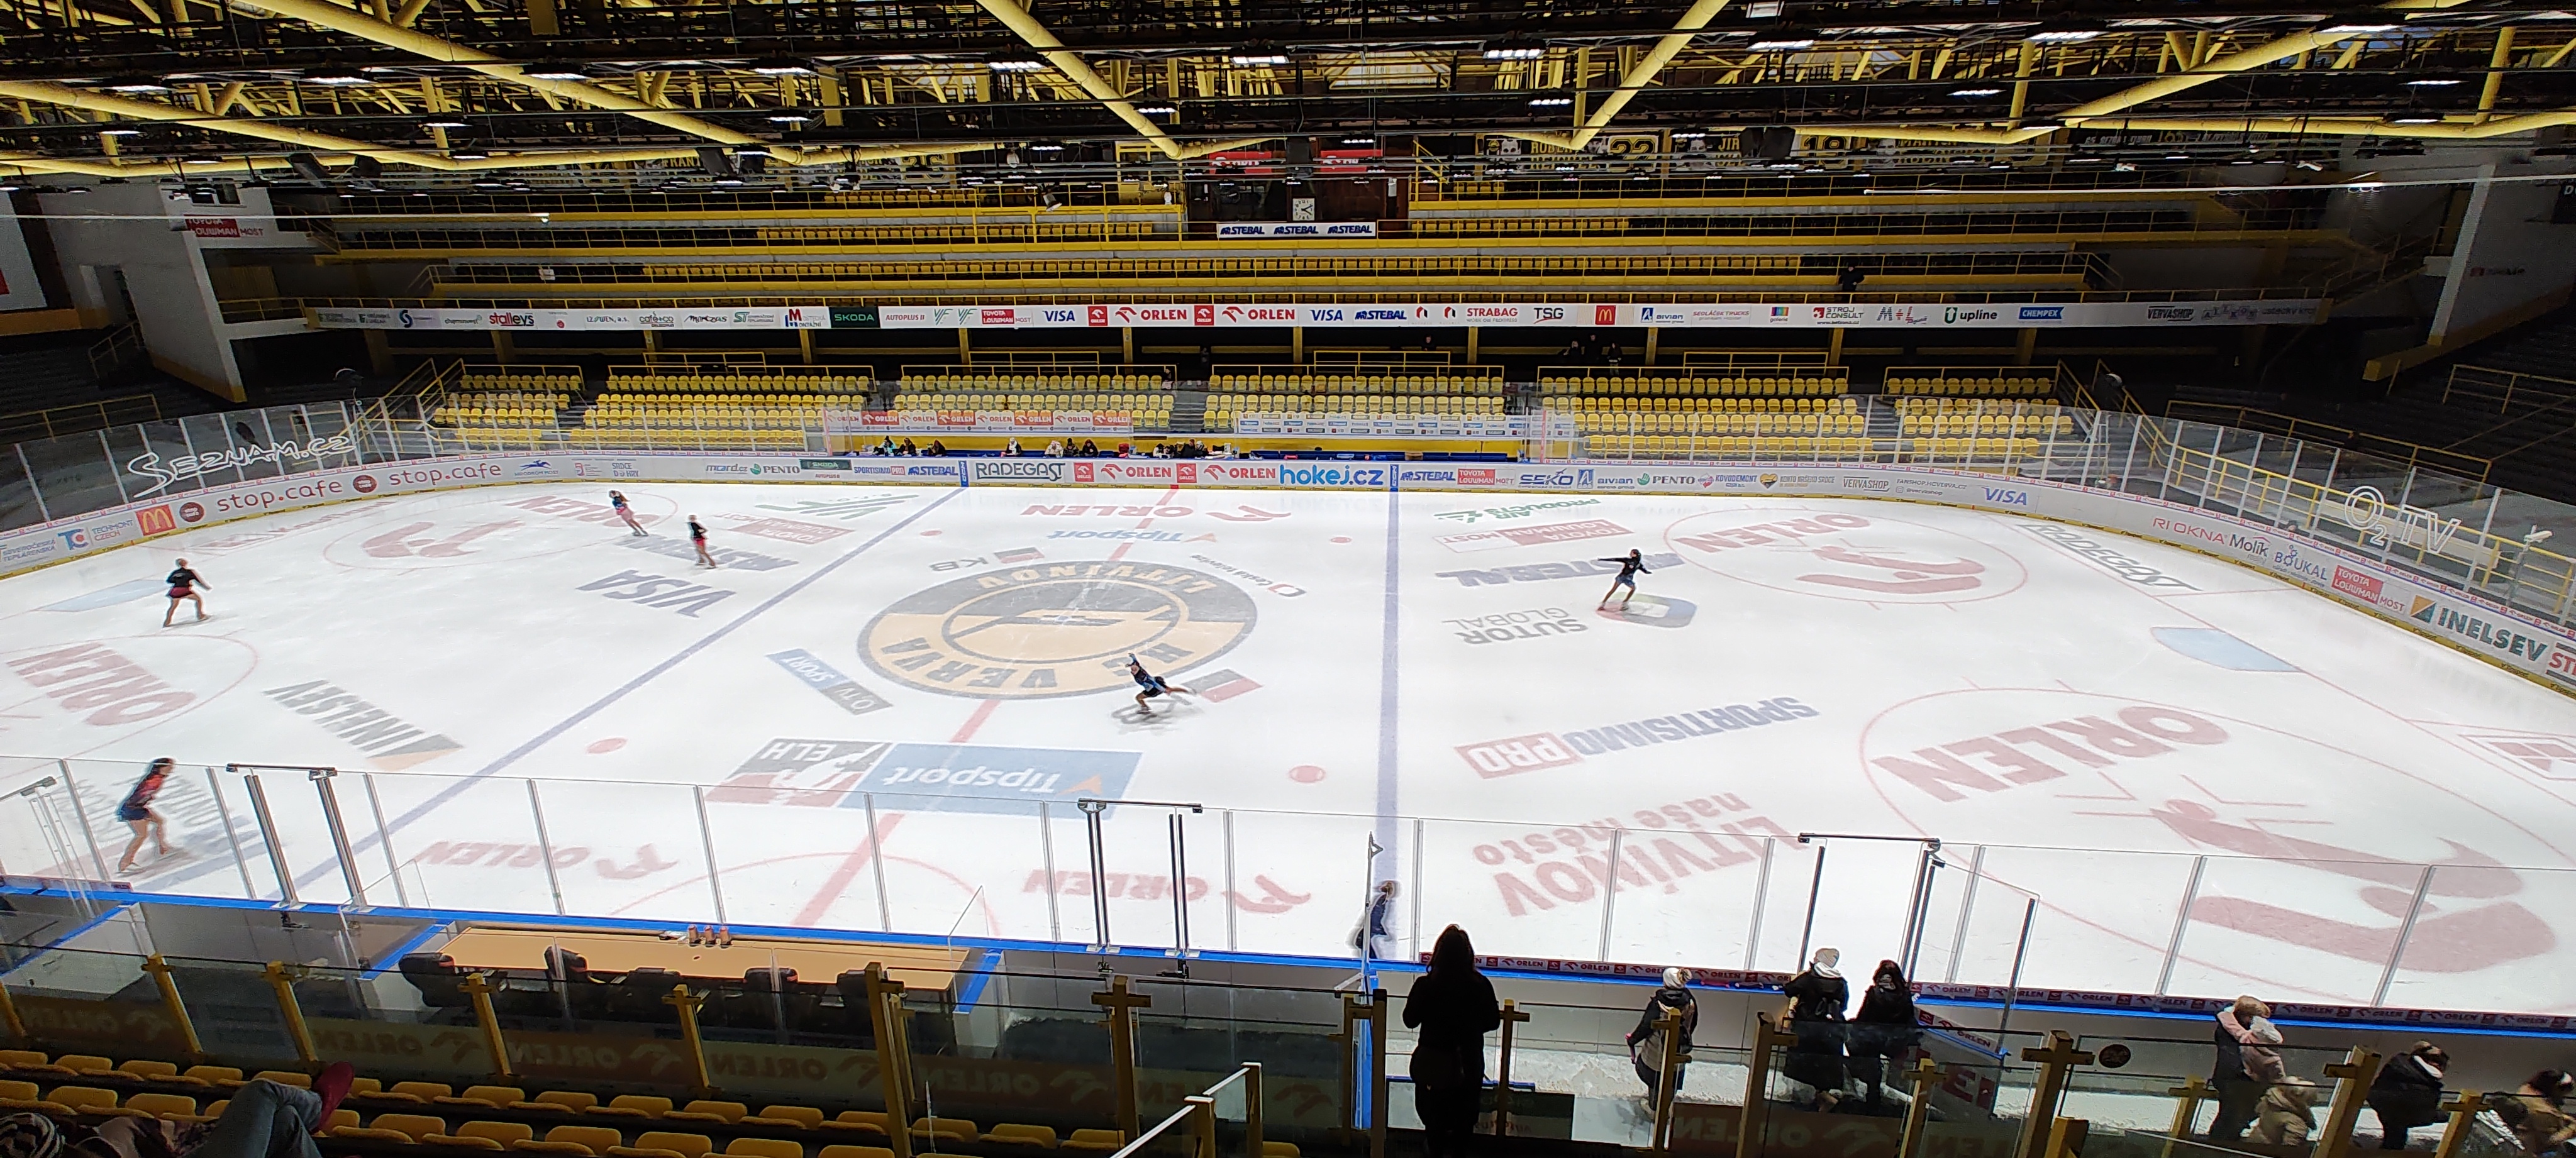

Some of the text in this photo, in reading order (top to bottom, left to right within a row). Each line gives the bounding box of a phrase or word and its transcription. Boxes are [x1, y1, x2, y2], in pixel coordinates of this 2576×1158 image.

[1043, 310, 1075, 321] VISA
[1141, 309, 1187, 320] ORLEN
[1248, 309, 1296, 320] ORLEN
[1309, 309, 1343, 321] VISA
[1467, 307, 1518, 316] STRABAG
[1534, 307, 1564, 319] TSG
[1960, 309, 1997, 321] upline
[2022, 309, 2058, 317] CHEMPEX
[2148, 308, 2194, 319] VERVASHOP
[489, 312, 534, 326] stalleys
[389, 462, 502, 485] stop.cafe
[763, 466, 801, 474] PENTO
[975, 462, 1066, 481] RADEGAST
[1126, 466, 1172, 478] ORLEN
[1229, 468, 1276, 478] ORLEN
[1279, 464, 1384, 486] hokej.cz
[1518, 473, 1574, 486] SEKO
[1652, 476, 1695, 484] PENTO
[1843, 478, 1889, 490] VERVASHOP
[217, 480, 343, 512] stop.cafe
[1982, 487, 2028, 506] VISA
[1022, 504, 1194, 518] ORLEN
[91, 519, 133, 535] TECHMONT
[1674, 513, 1872, 554] ORLEN
[2153, 517, 2224, 545] RI OKNA
[2399, 504, 2462, 554] TV
[95, 530, 121, 541] CZECH
[758, 529, 822, 542] TOYOTA
[1047, 529, 1184, 543] Tipsport
[1543, 527, 1622, 541] TOYOTA
[2338, 568, 2370, 588] TOYOTA
[2334, 578, 2377, 602] LOUWMAN
[2379, 597, 2405, 612] MOST
[1441, 607, 1571, 631] GLOBAL
[1454, 618, 1589, 645] SUTOR
[2438, 607, 2548, 662] INELSEV
[1467, 696, 1821, 773] SPORTISIMO PRO
[1870, 705, 2230, 803] ORLEN
[881, 766, 1062, 795] Tipsport
[1516, 959, 1543, 968] ORLEN
[1581, 963, 1610, 973] ORLEN
[1710, 970, 1741, 979] ORLEN
[1942, 986, 1970, 995] ORLEN
[2082, 994, 2112, 1003] ORLEN
[2444, 1012, 2477, 1022] ORLEN
[1957, 1030, 1991, 1049] ORLEN
